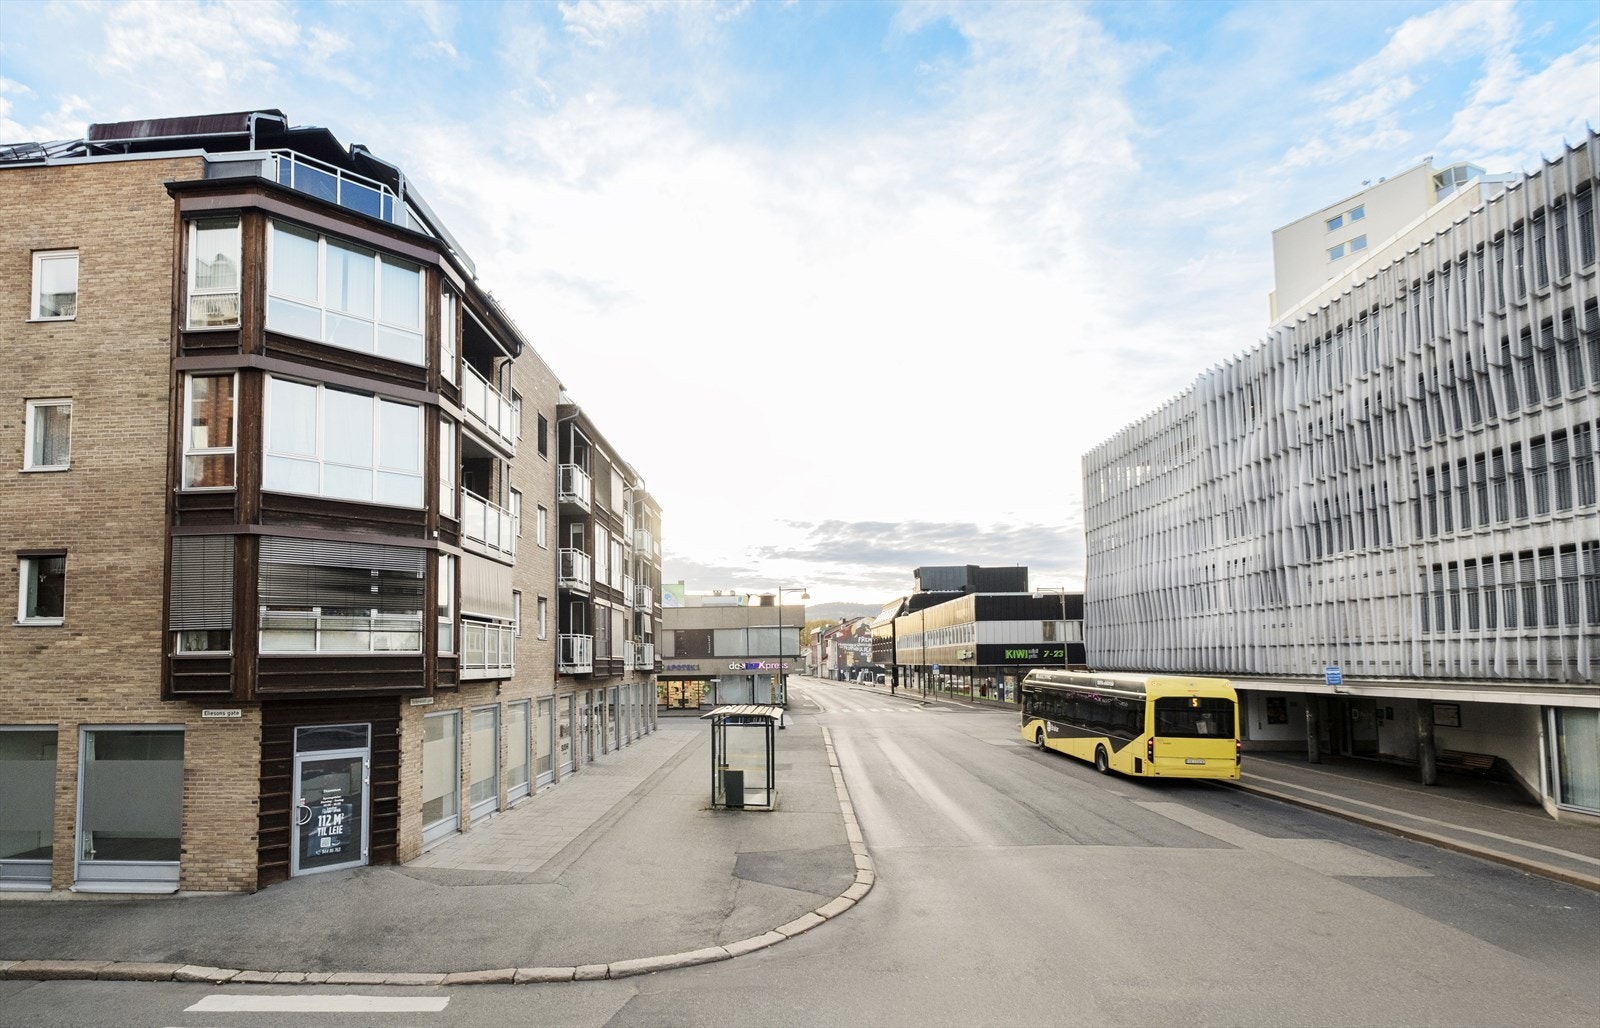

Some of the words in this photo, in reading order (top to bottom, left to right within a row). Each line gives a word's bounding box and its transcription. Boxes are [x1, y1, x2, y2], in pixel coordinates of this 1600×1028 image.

[1005, 649, 1028, 659] KIWI
[1192, 698, 1198, 707] 5
[318, 815, 331, 827] 112
[317, 827, 327, 836] TIL
[329, 825, 343, 835] LEIE
